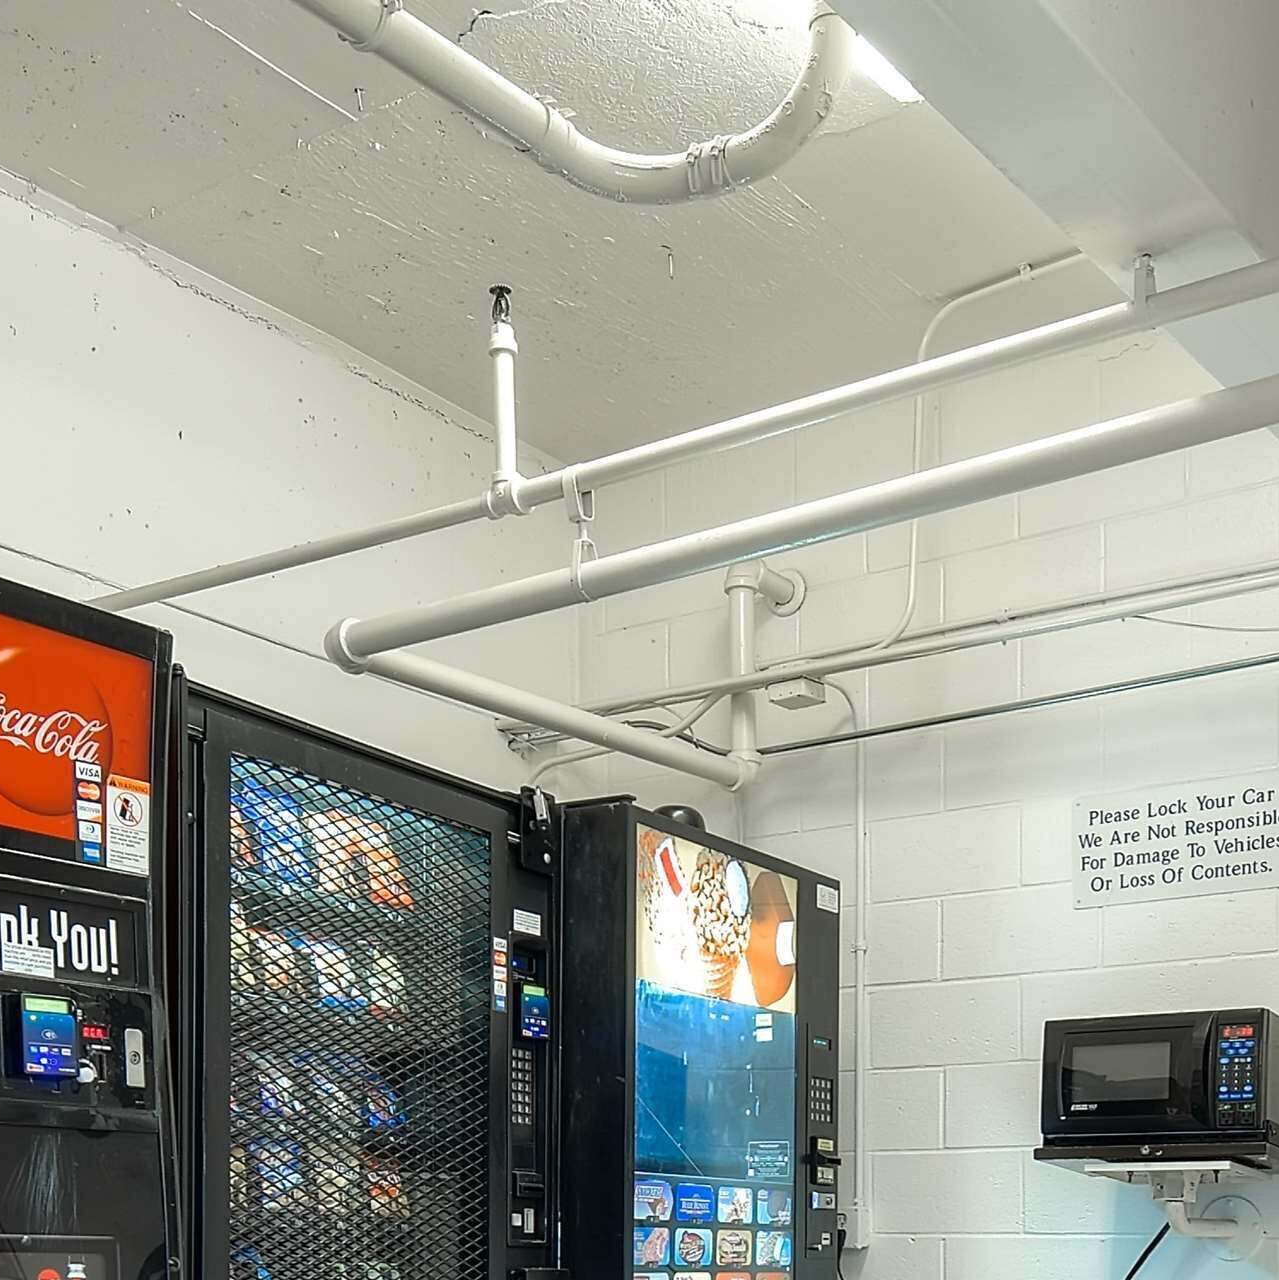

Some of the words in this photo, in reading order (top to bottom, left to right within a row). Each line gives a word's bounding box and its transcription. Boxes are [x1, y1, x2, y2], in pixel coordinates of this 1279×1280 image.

[79, 767, 100, 778] VISA
[1088, 807, 1140, 826] Please
[1147, 799, 1187, 818] Lock
[1196, 794, 1235, 812] Your
[1242, 788, 1275, 805] Car
[1078, 833, 1102, 849] We
[1110, 828, 1140, 846] Are
[1147, 824, 1177, 841] Not
[1081, 855, 1107, 872] For
[1113, 848, 1180, 868] Damage
[1187, 842, 1206, 858] To
[1090, 876, 1113, 892] Or
[1120, 872, 1155, 889] Loss
[1161, 867, 1184, 884] Of
[1191, 860, 1273, 881] Contents.
[50, 909, 120, 976] You!
